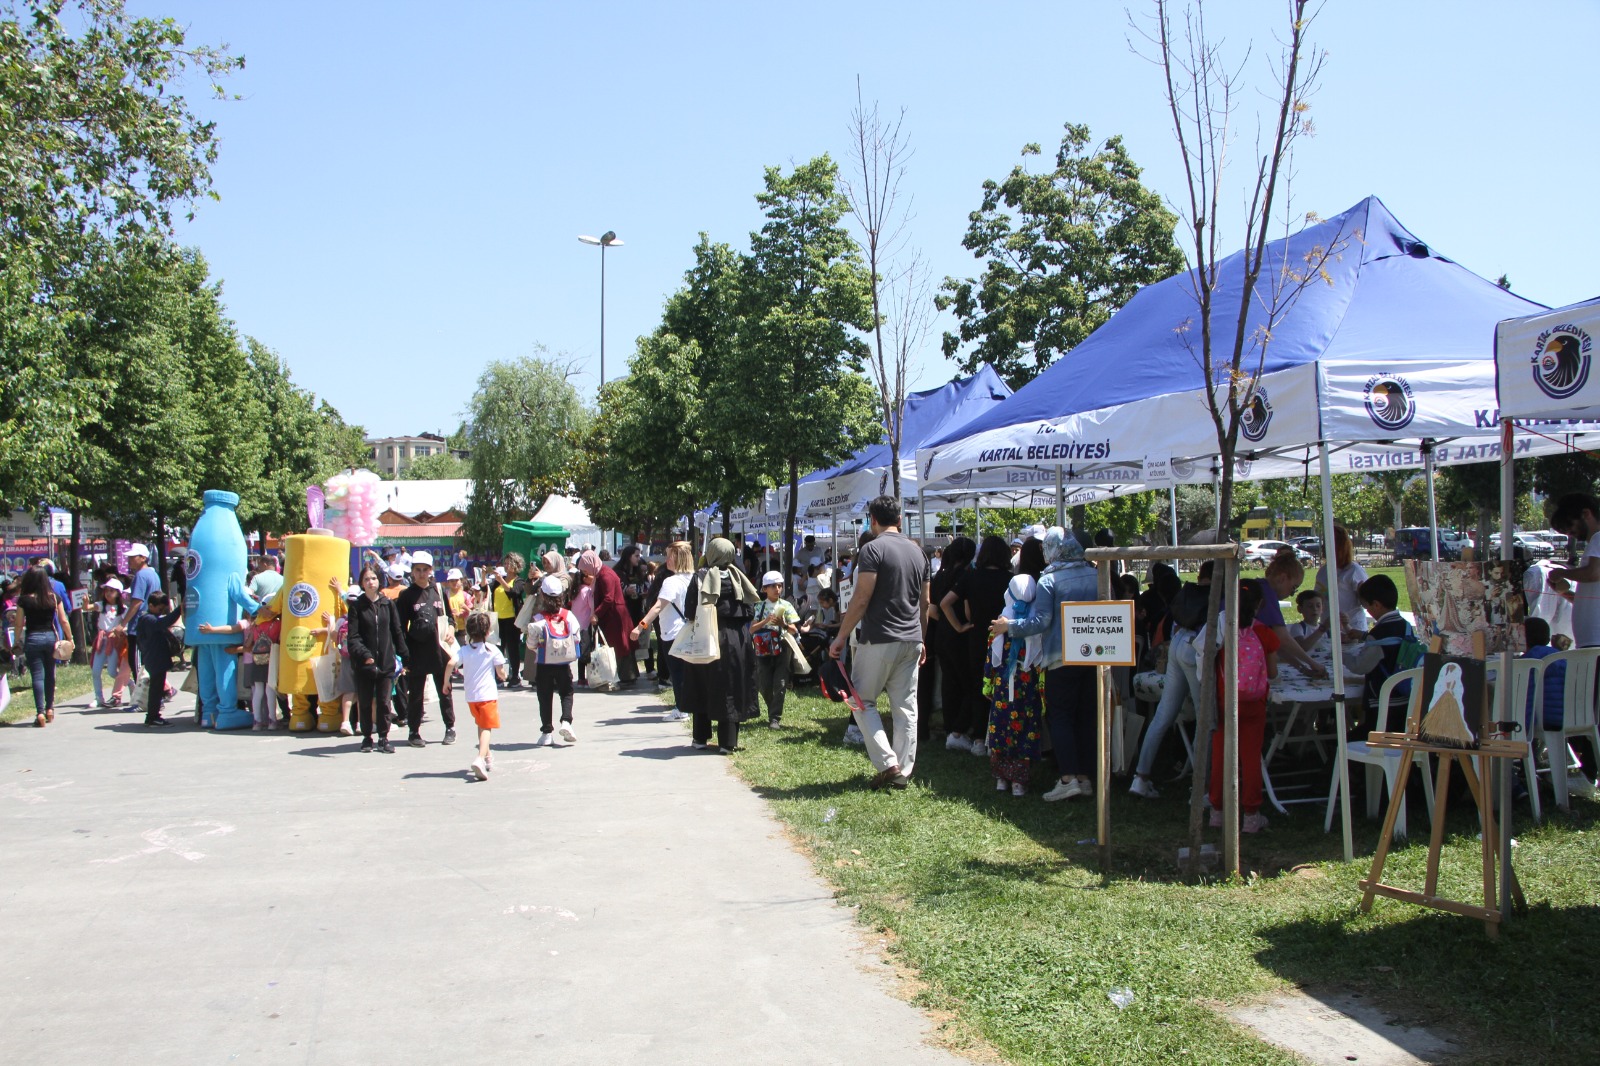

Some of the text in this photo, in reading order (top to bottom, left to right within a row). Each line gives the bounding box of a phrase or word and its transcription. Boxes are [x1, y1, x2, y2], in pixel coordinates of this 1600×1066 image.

[1531, 324, 1592, 363] KARTAL BELEDİYESİ
[979, 438, 1111, 462] KARTAL BELEDİYESİ
[1072, 614, 1122, 624] TEMİZ ÇEVRE
[1072, 625, 1124, 635] TEMİZ YAŞAM
